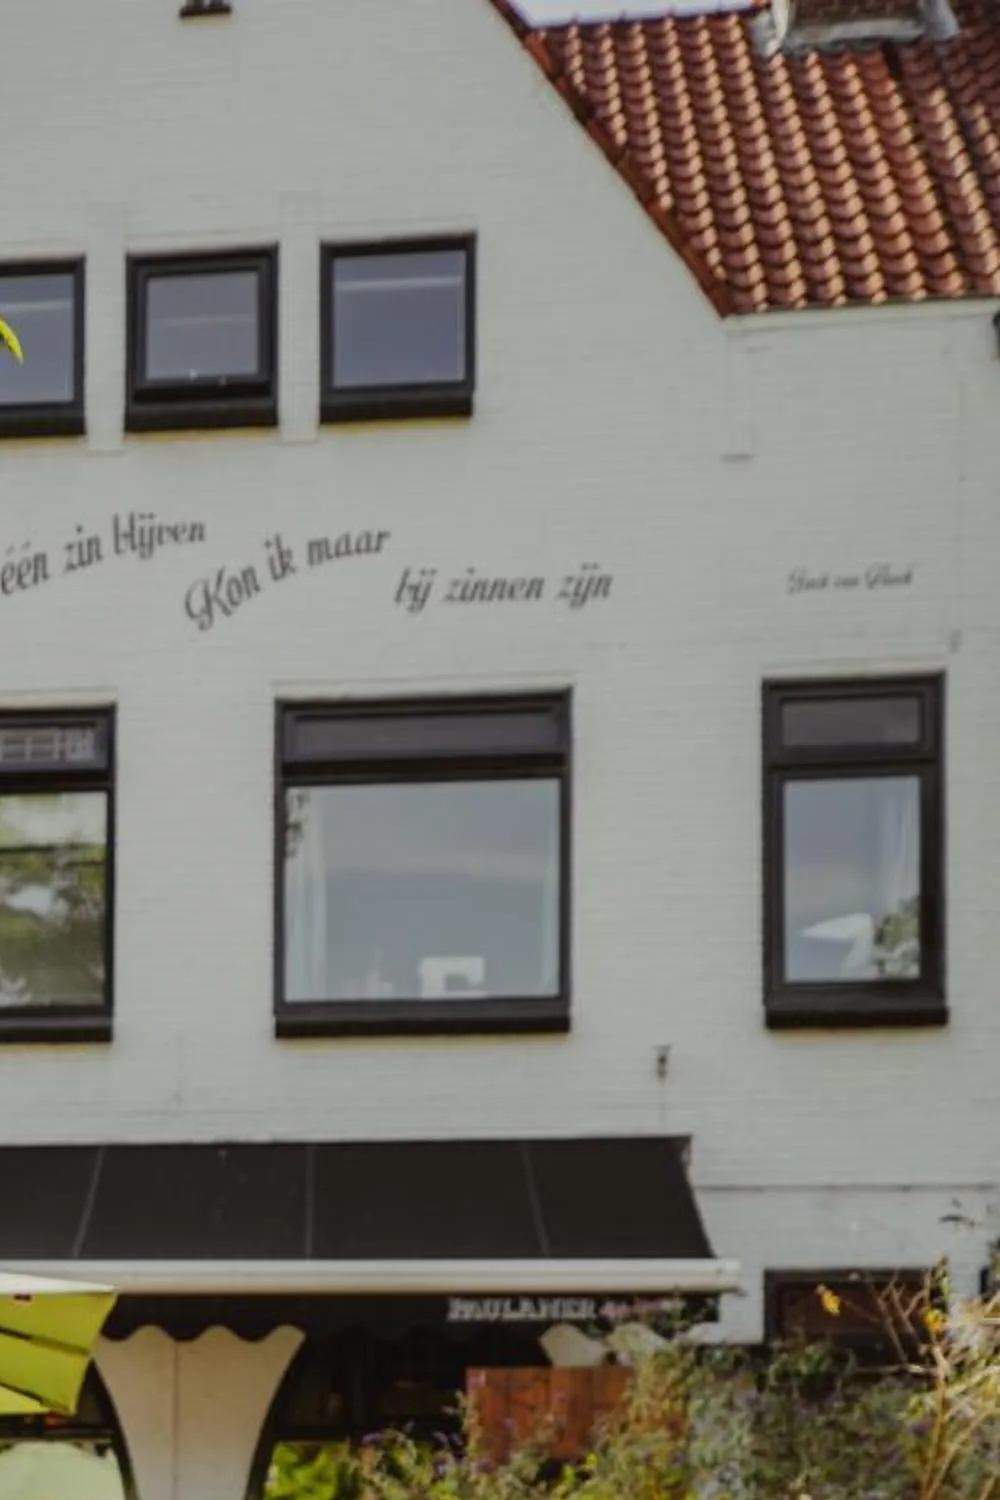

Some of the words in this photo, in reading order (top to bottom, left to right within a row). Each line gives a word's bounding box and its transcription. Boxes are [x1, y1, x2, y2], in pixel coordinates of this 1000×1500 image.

[63, 524, 103, 573] zin
[184, 566, 262, 632] Kon
[264, 533, 297, 583] ik
[306, 528, 391, 568] maar
[444, 566, 545, 604] zinnen
